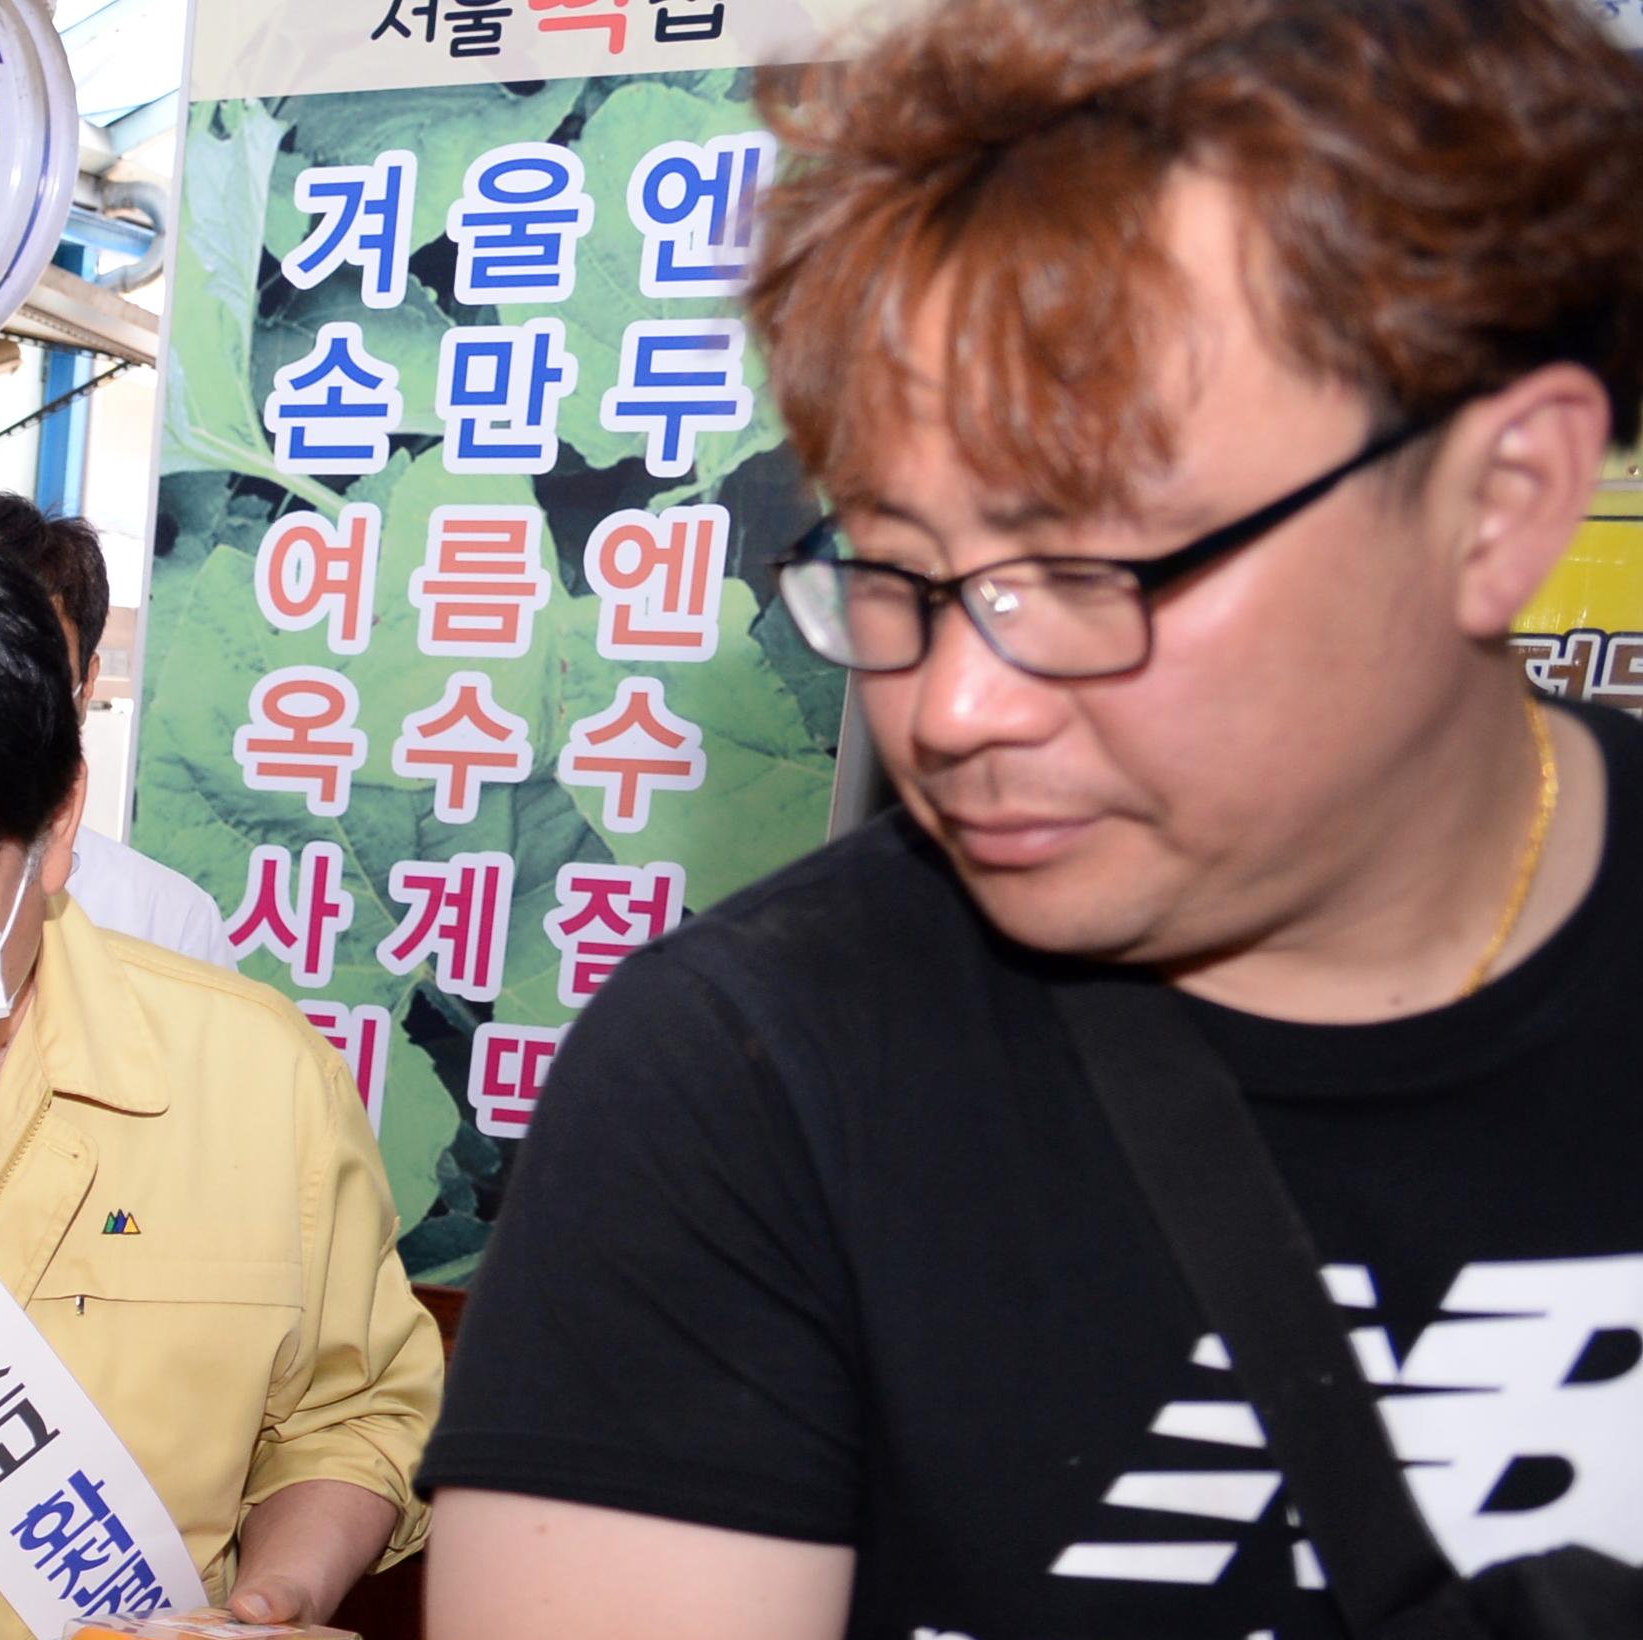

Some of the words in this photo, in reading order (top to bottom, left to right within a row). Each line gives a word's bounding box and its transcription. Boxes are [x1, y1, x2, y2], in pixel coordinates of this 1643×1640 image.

[281, 146, 763, 294] 겨울엔
[277, 330, 740, 464] 손만두
[265, 516, 715, 650] 여름엔
[245, 678, 693, 822] 옥수수
[10, 1468, 173, 1620] 화천경
